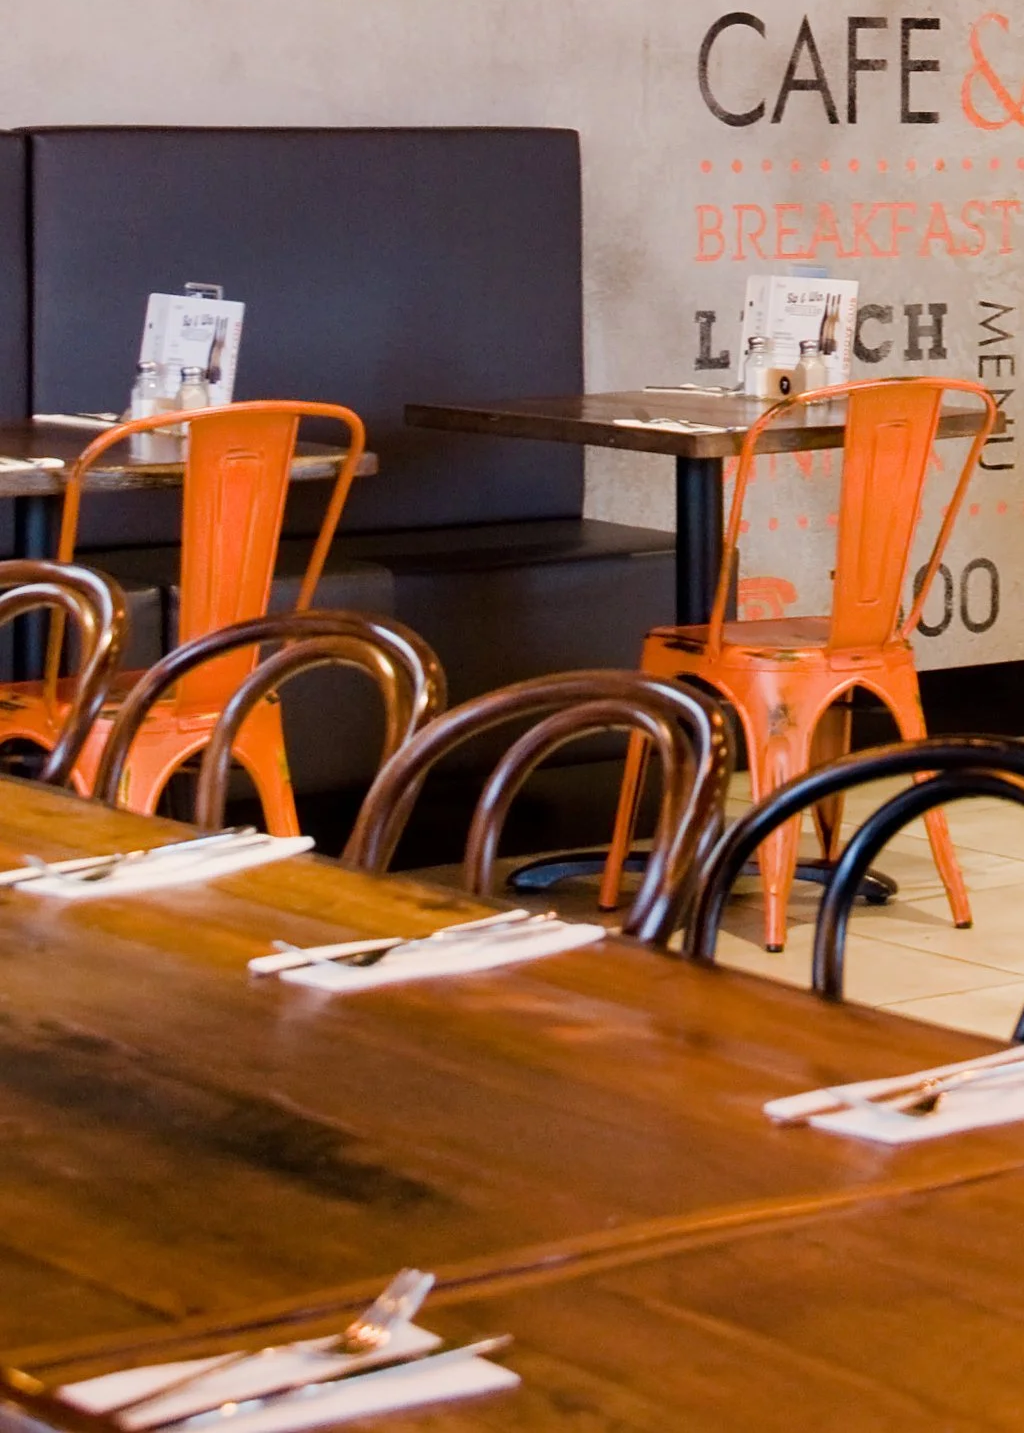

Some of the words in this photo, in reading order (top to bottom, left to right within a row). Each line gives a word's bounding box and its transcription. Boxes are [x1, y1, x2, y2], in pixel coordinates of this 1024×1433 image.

[698, 12, 940, 127] CAFE
[696, 200, 1021, 262] BREAKFAST
[694, 303, 949, 371] LCH
